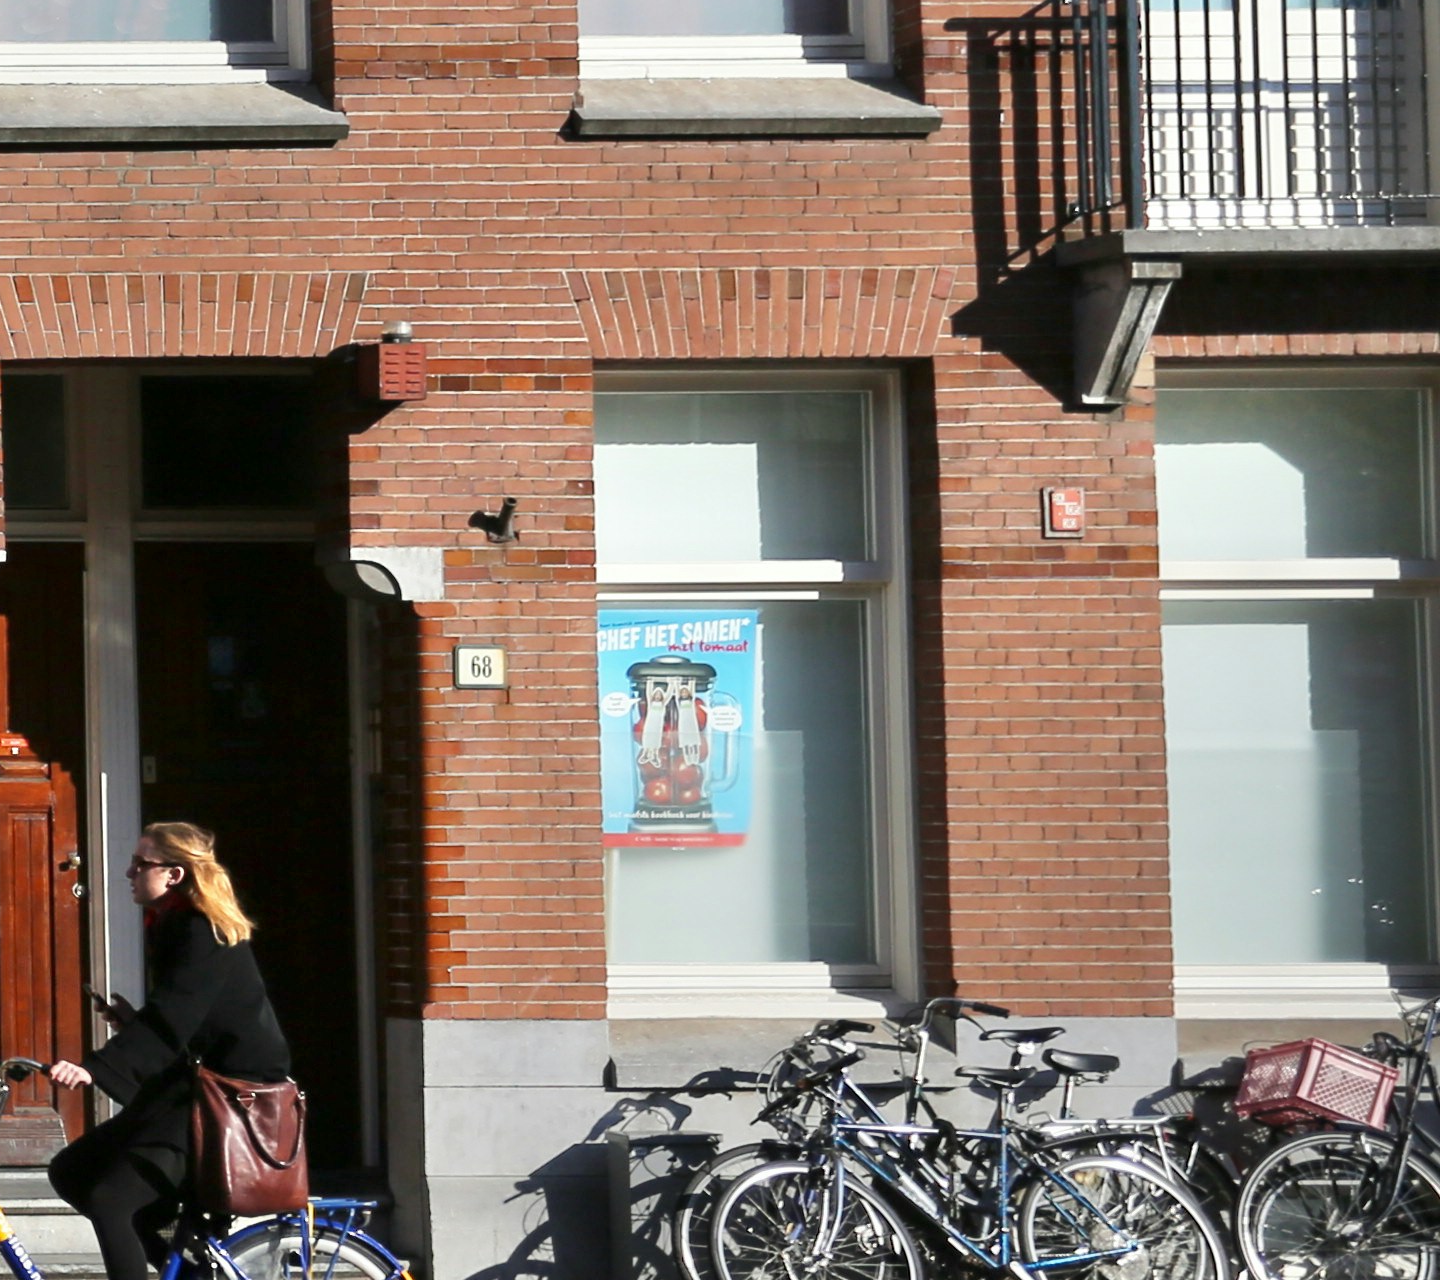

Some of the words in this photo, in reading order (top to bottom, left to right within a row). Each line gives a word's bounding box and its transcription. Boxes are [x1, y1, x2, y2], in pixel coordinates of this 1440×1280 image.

[597, 627, 641, 652] CHEF
[645, 623, 679, 648] HET
[668, 640, 694, 652] met
[699, 640, 748, 652] tomaat
[471, 655, 492, 678] 68
